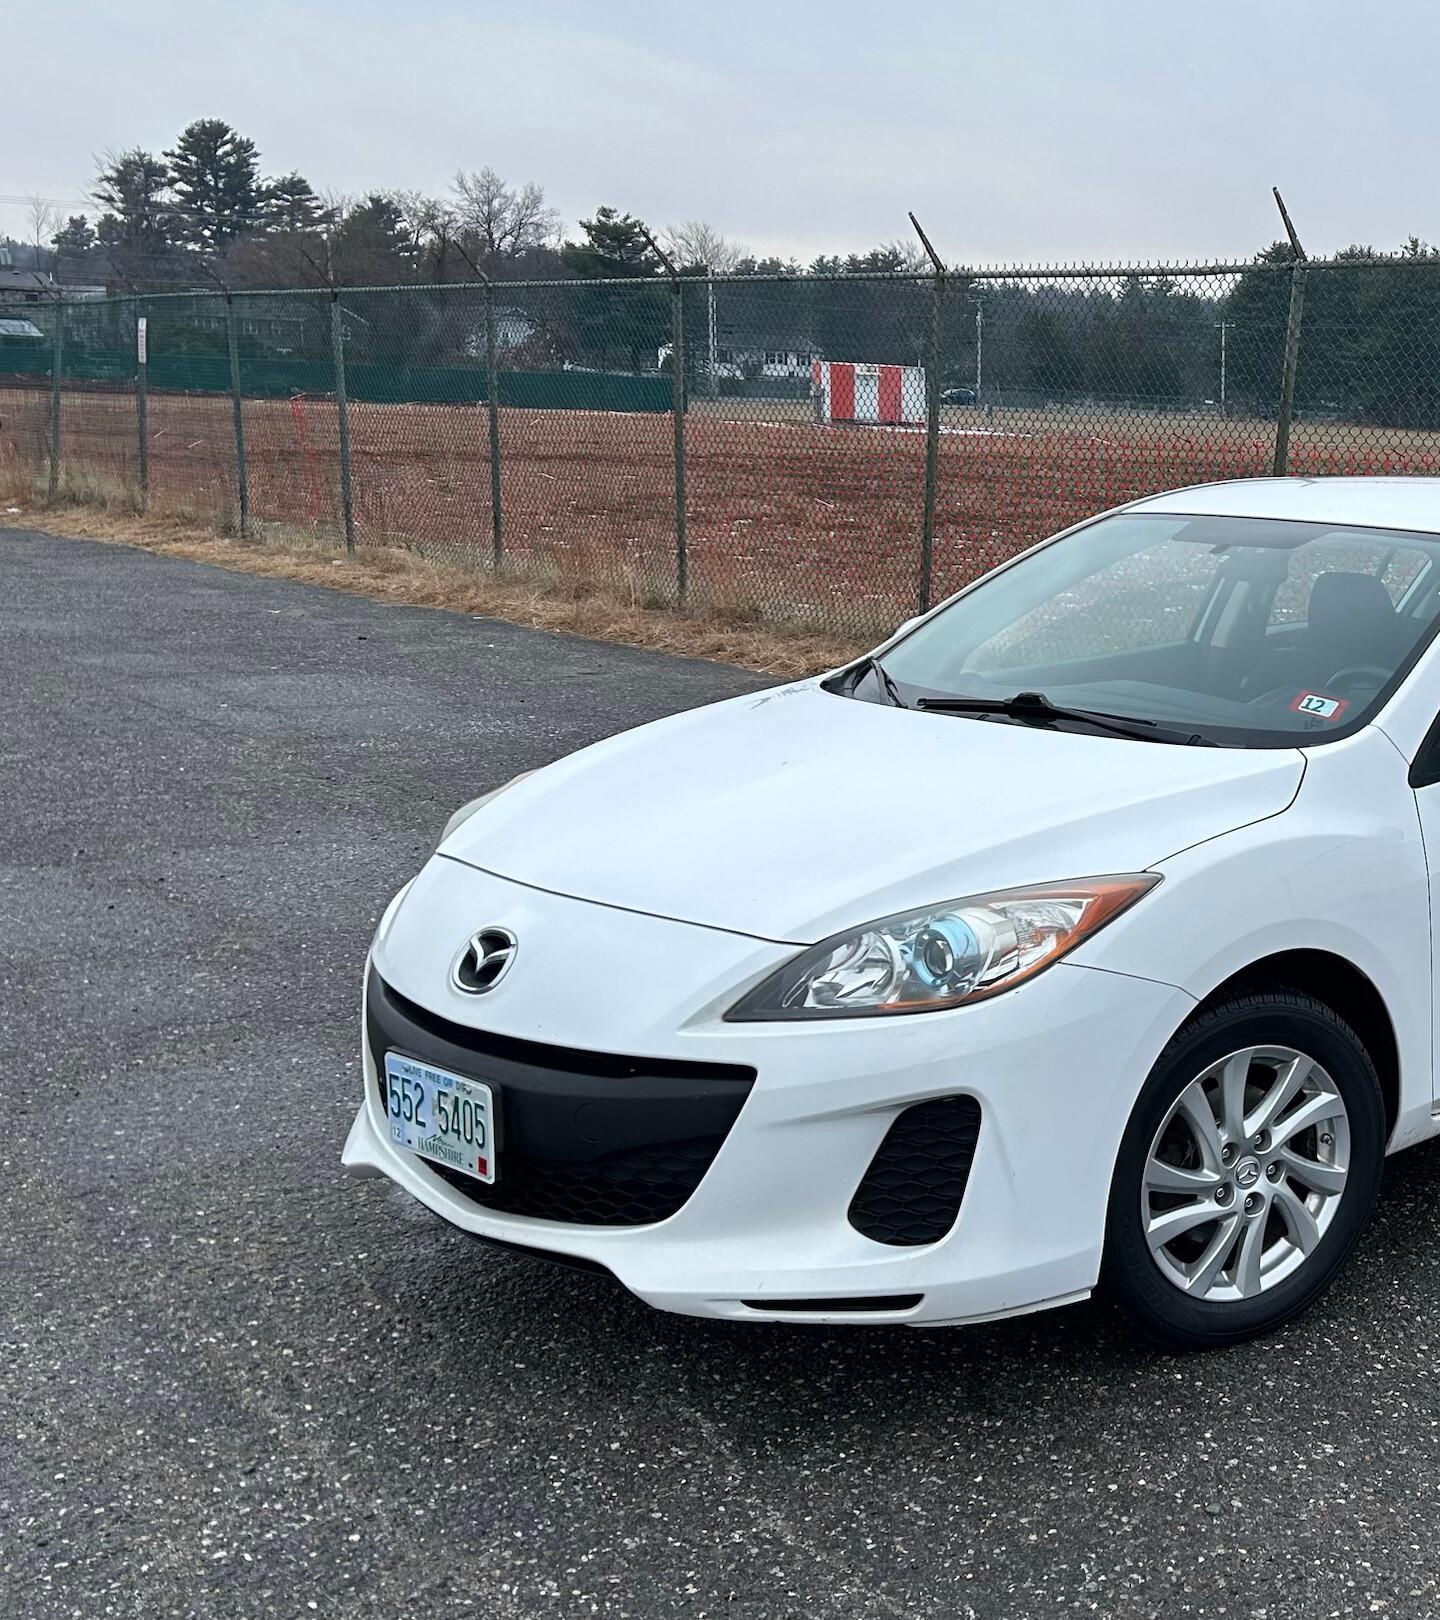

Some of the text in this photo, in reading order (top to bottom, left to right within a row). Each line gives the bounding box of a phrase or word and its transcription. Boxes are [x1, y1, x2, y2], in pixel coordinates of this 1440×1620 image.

[1301, 698, 1326, 713] 12
[425, 1070, 441, 1084] FREE
[443, 1076, 453, 1088] OR
[389, 1073, 485, 1149] 552 5405
[418, 1137, 464, 1164] HAMPSHIRE
